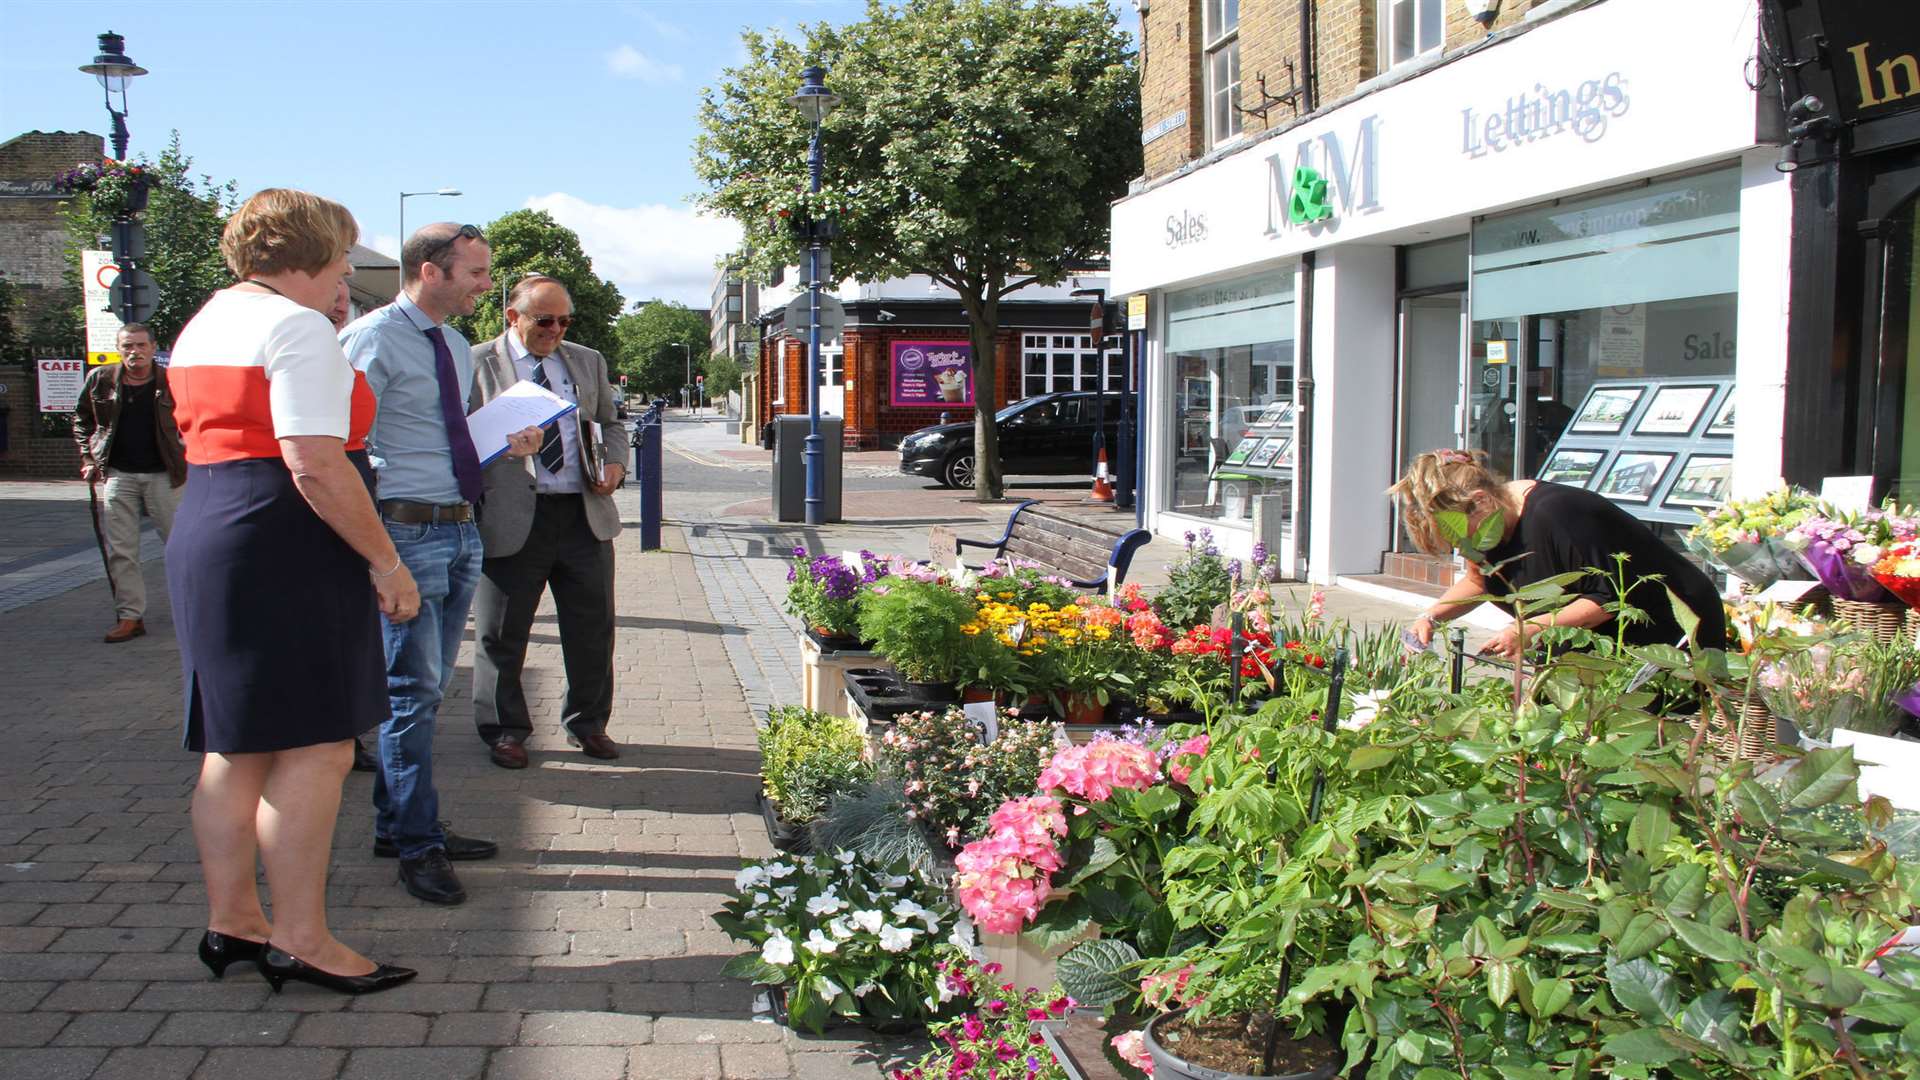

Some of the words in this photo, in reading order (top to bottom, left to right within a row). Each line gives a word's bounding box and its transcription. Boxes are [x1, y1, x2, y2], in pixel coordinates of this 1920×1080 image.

[1461, 72, 1624, 154] Lettings
[1166, 209, 1204, 246] Sales
[41, 362, 81, 371] CAFE
